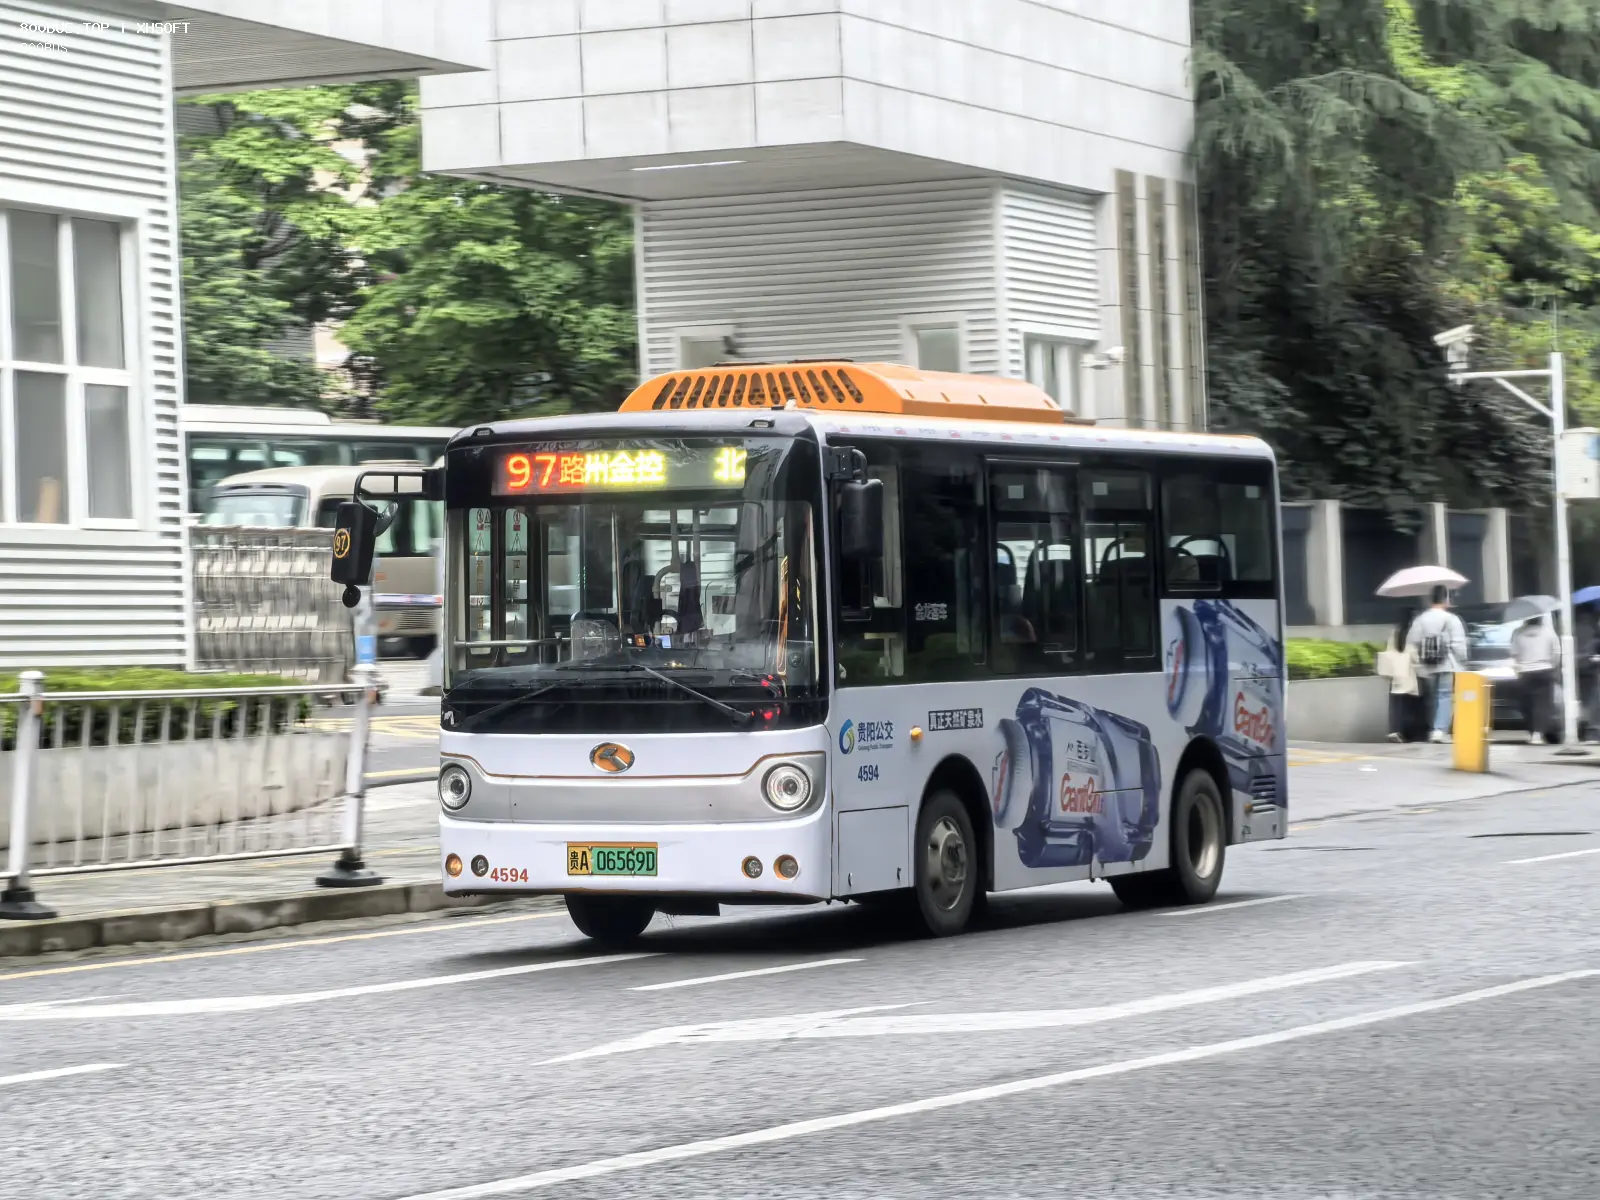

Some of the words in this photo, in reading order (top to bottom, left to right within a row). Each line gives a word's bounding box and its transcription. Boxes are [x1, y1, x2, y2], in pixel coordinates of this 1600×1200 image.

[336, 535, 347, 552] 97
[857, 720, 894, 743] 贵阳公交
[857, 764, 879, 782] 4594
[490, 867, 529, 882] 4594
